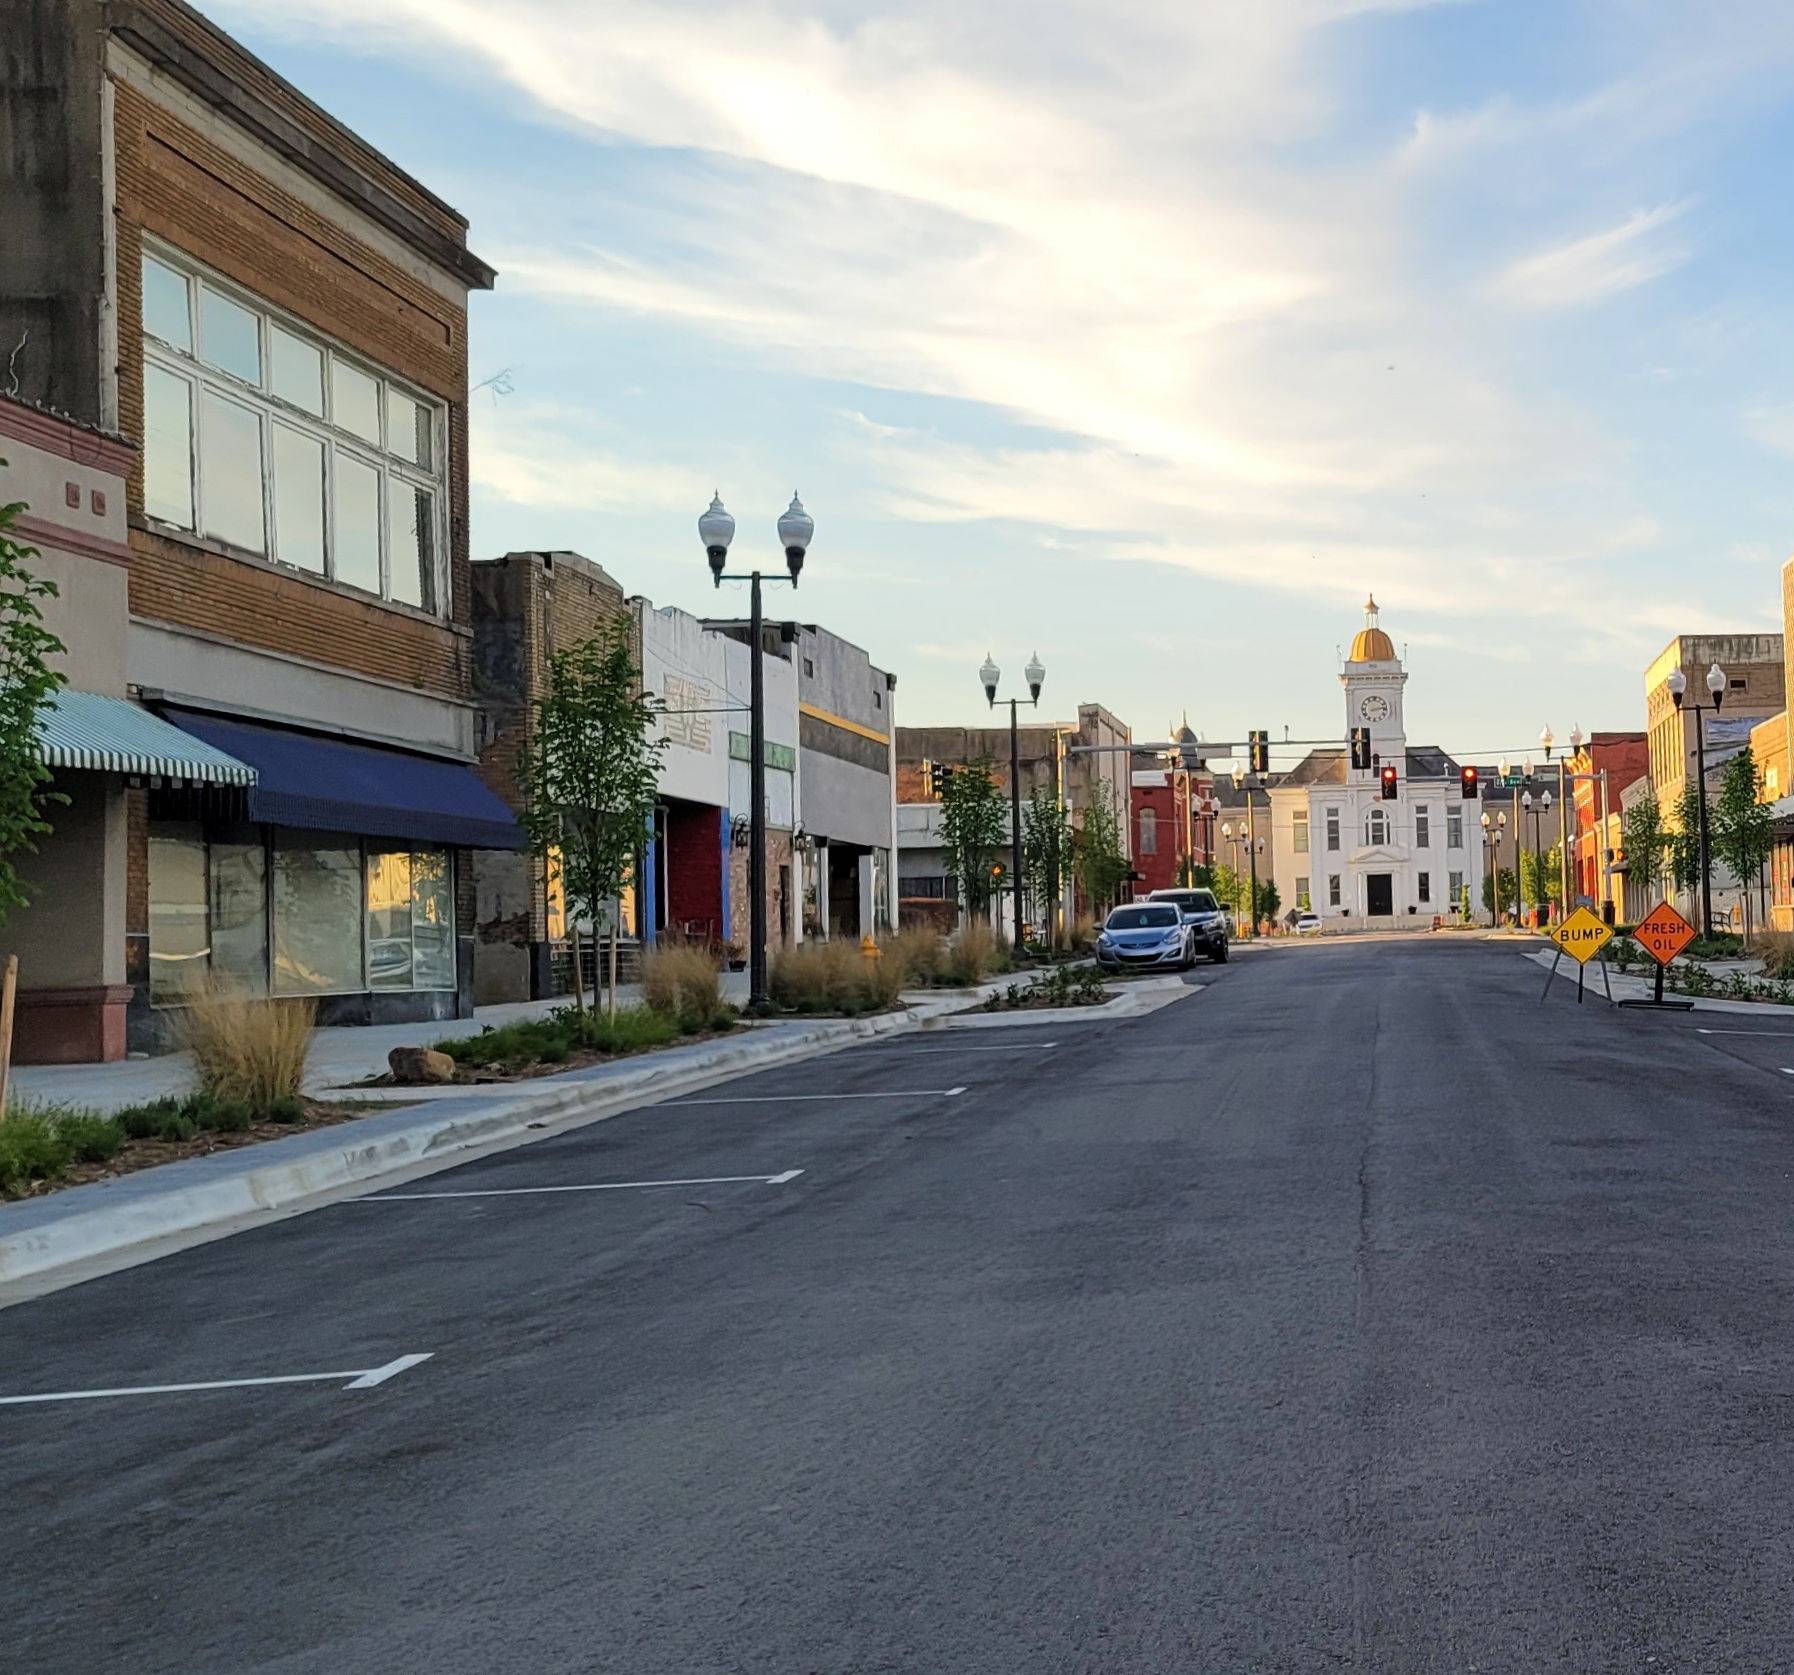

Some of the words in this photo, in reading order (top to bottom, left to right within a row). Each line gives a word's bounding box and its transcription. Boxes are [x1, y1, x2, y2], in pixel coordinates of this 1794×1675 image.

[1560, 927, 1604, 941] BUMP
[1644, 922, 1685, 934] FRESH
[1653, 938, 1676, 951] OIL
